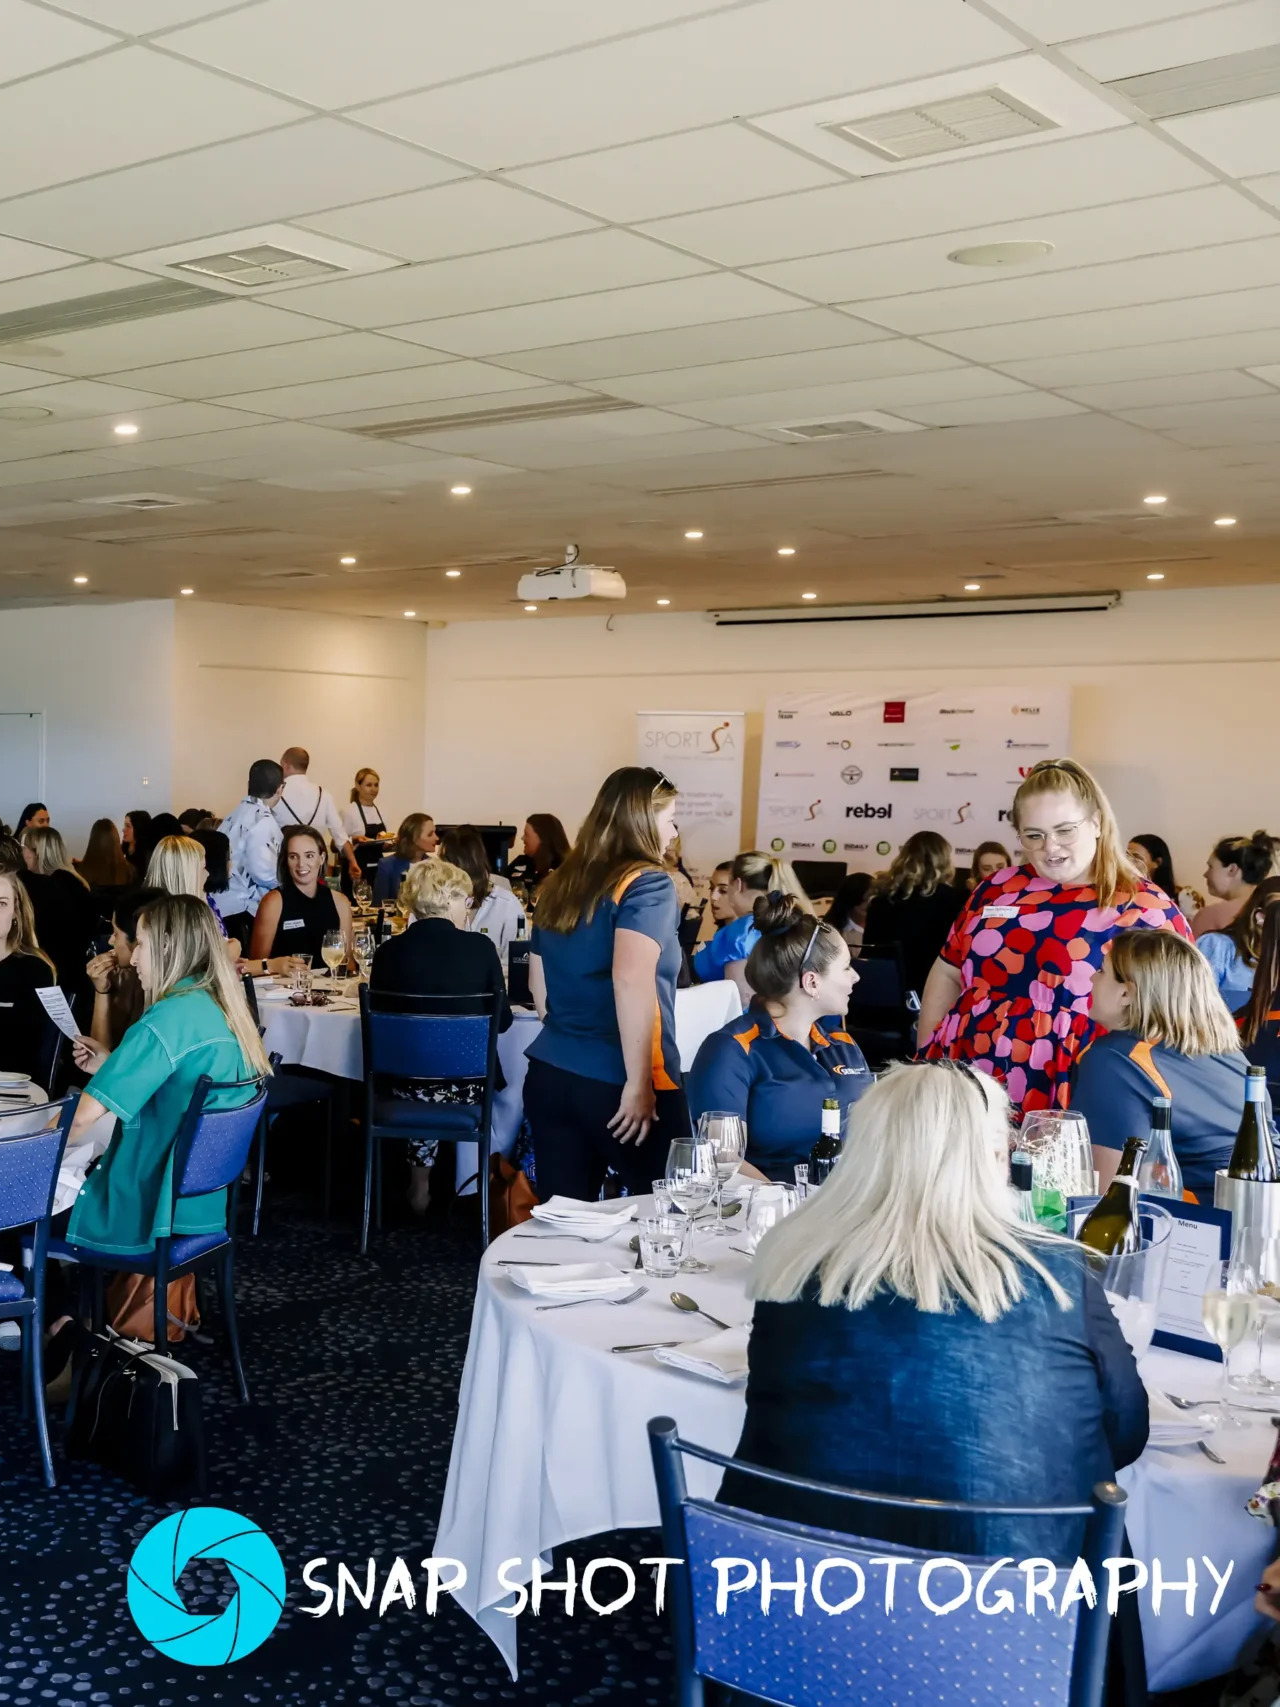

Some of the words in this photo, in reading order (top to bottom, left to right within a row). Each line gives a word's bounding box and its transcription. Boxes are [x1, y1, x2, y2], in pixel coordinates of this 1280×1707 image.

[644, 731, 702, 749] SPORT
[768, 804, 805, 817] SPORT
[845, 803, 892, 819] rebel
[913, 807, 952, 821] SPORT
[1177, 1219, 1198, 1230] Menu
